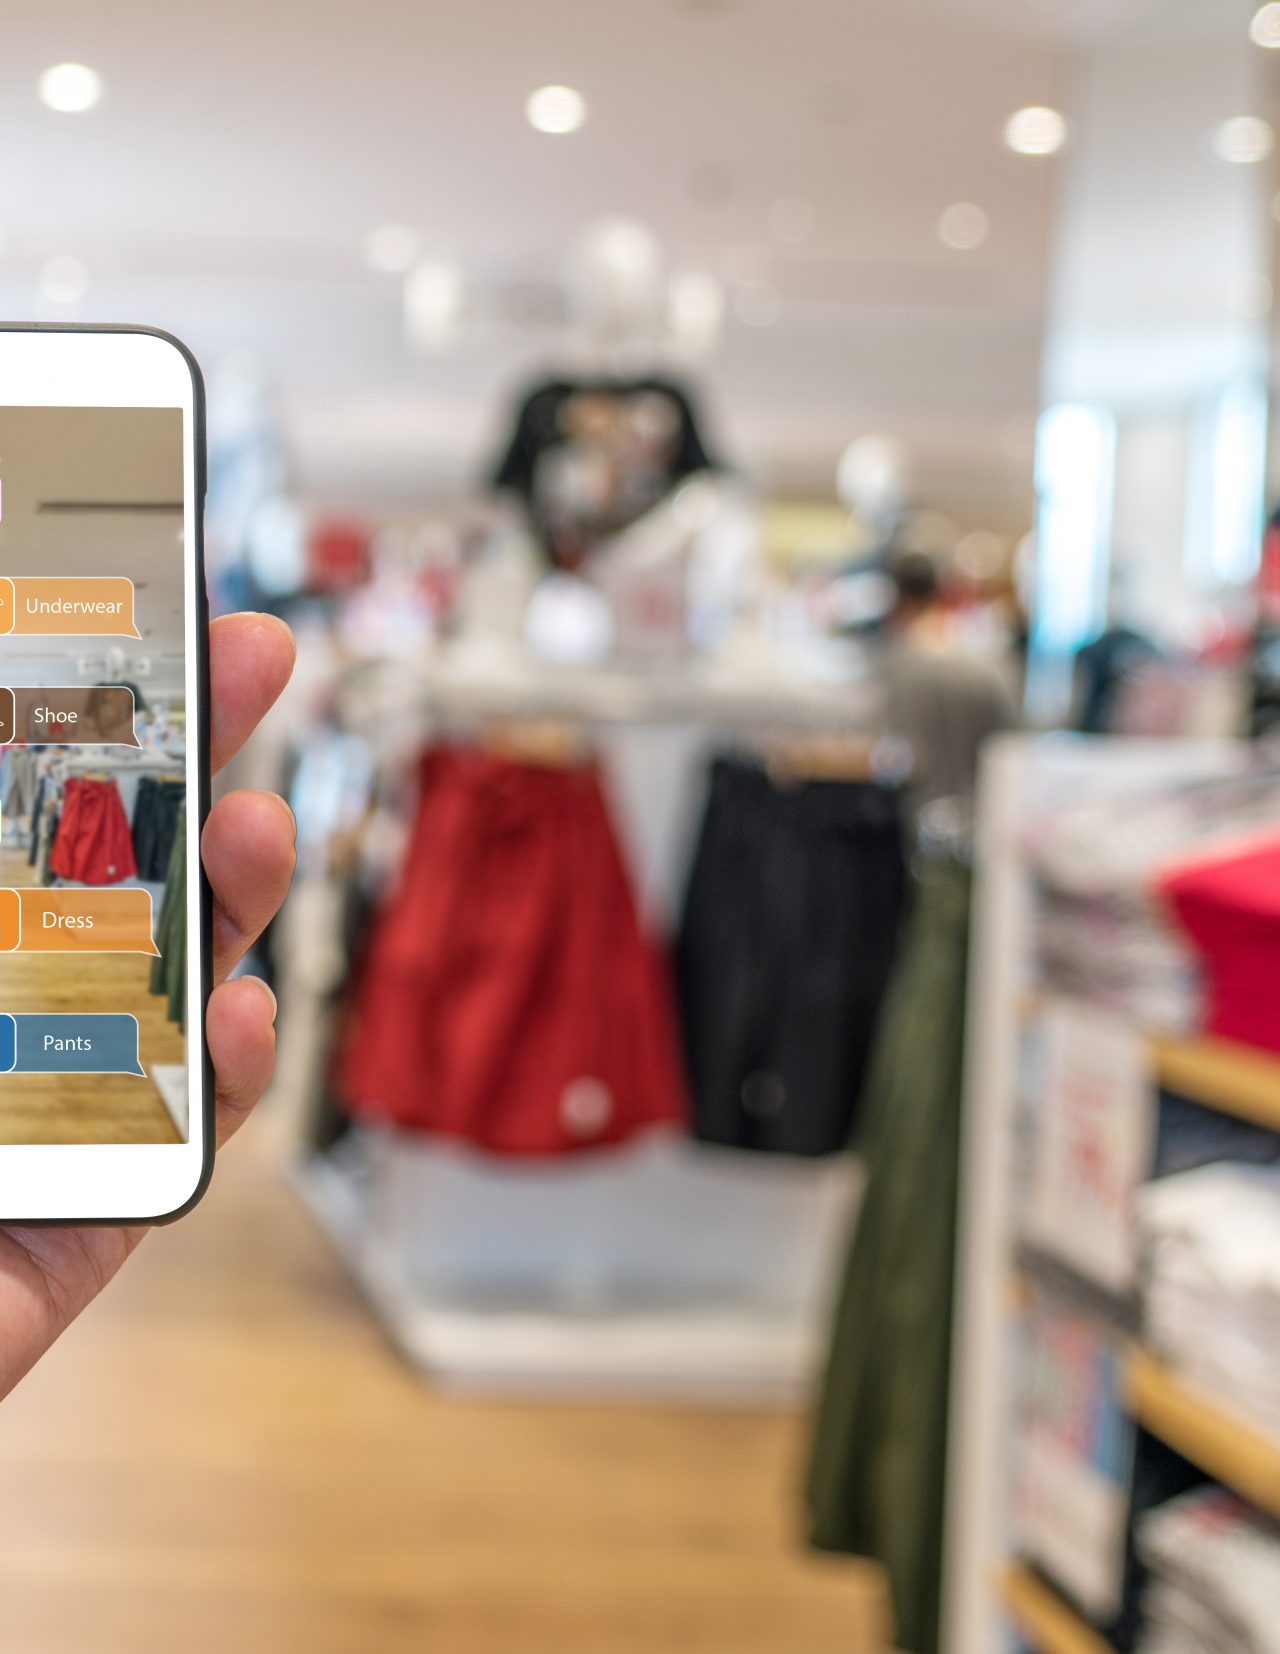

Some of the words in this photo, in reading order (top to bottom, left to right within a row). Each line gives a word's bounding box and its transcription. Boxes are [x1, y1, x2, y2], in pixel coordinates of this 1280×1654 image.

[26, 598, 123, 614] Underwear
[34, 708, 78, 723] Shoe
[42, 911, 94, 929] Dress
[43, 1035, 92, 1051] Pants
